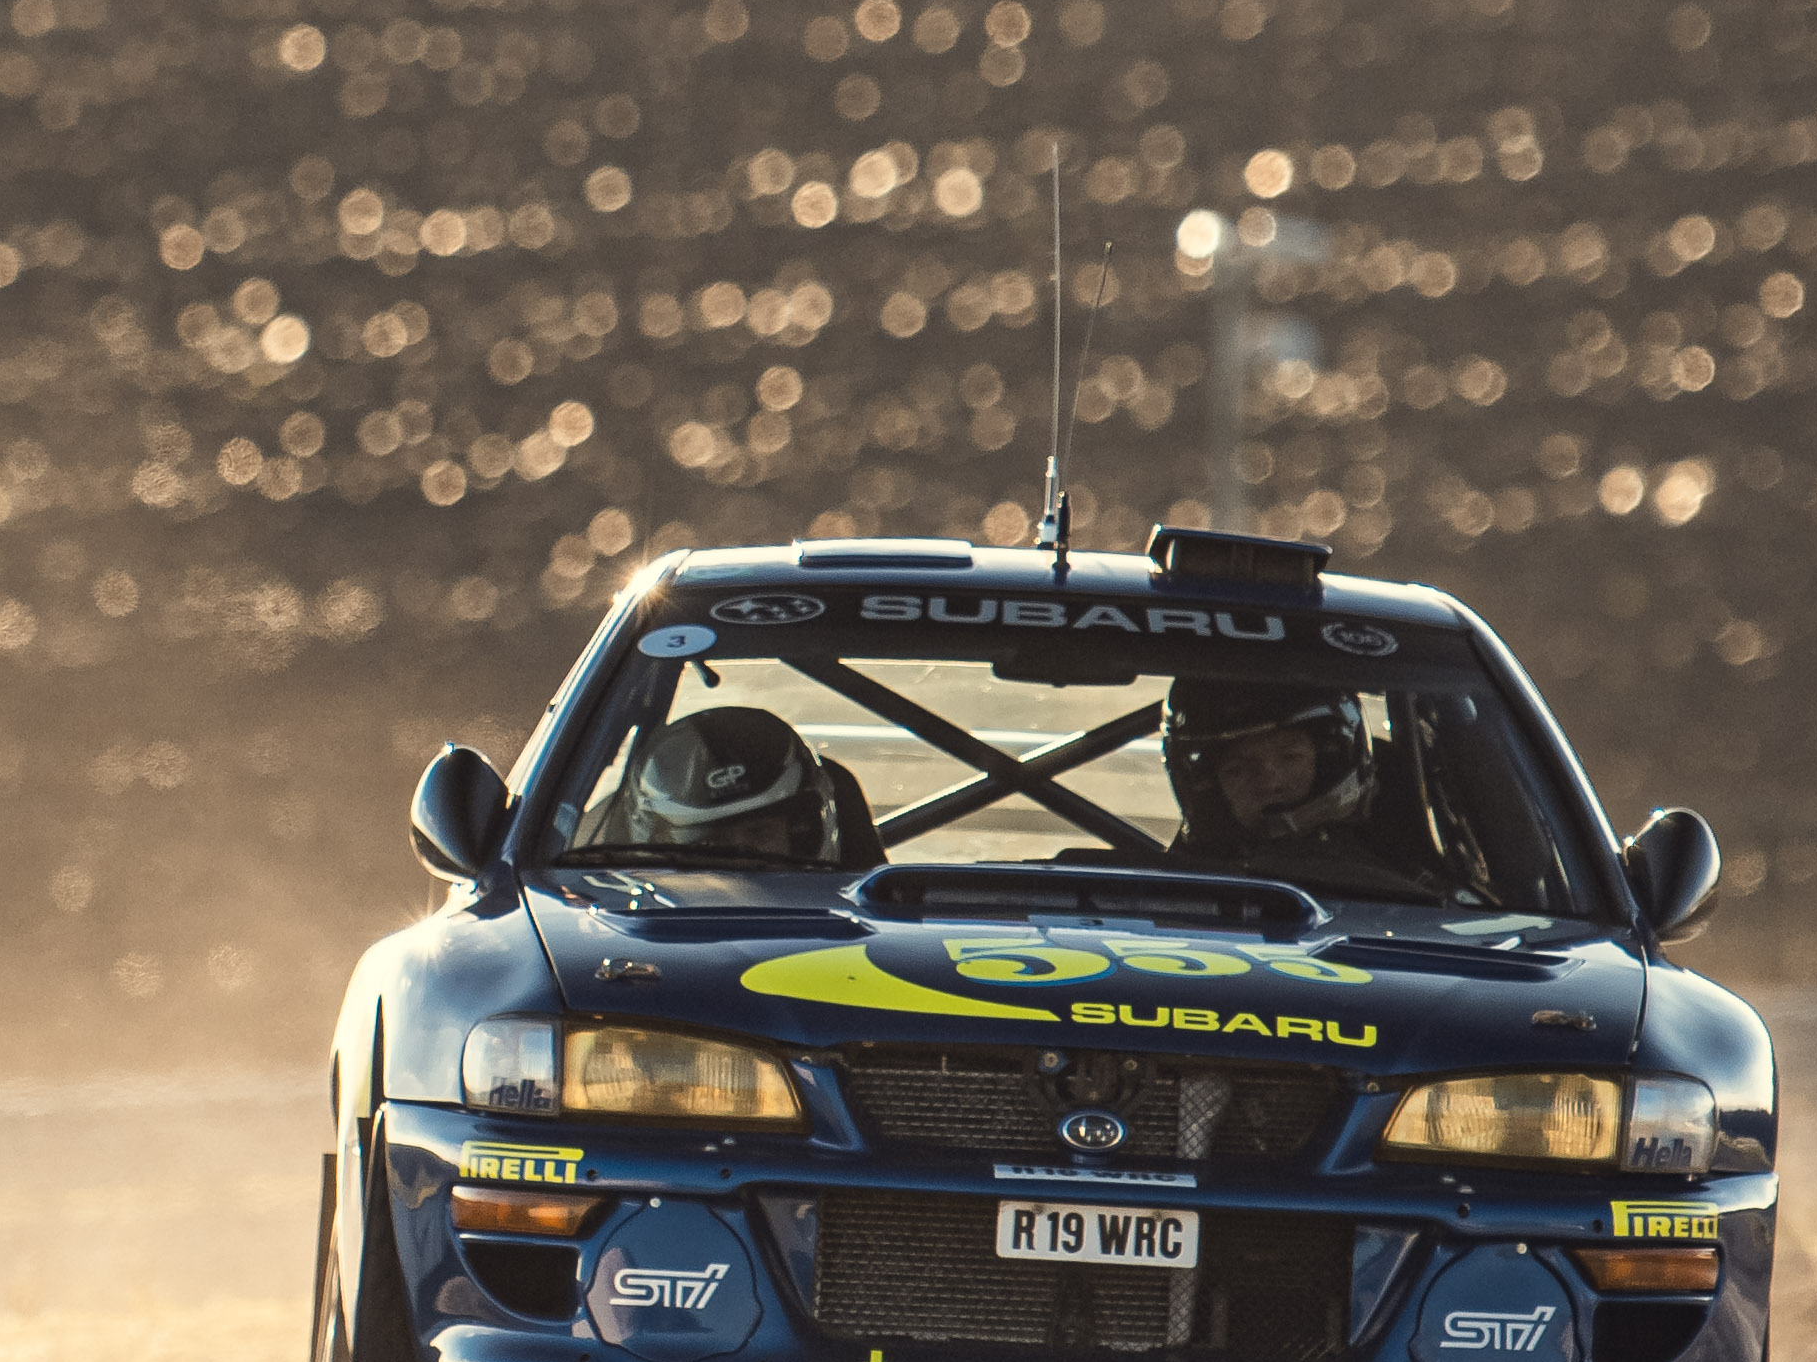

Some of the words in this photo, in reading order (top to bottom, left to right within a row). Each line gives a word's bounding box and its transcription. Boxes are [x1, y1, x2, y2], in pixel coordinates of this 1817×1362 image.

[861, 595, 1286, 640] SUBARU
[666, 635, 687, 648] 3
[943, 937, 1374, 987] 555
[1069, 1001, 1377, 1048] SUBARU
[1012, 1209, 1036, 1250] R
[1047, 1211, 1085, 1254] 19
[1098, 1213, 1183, 1259] WRC
